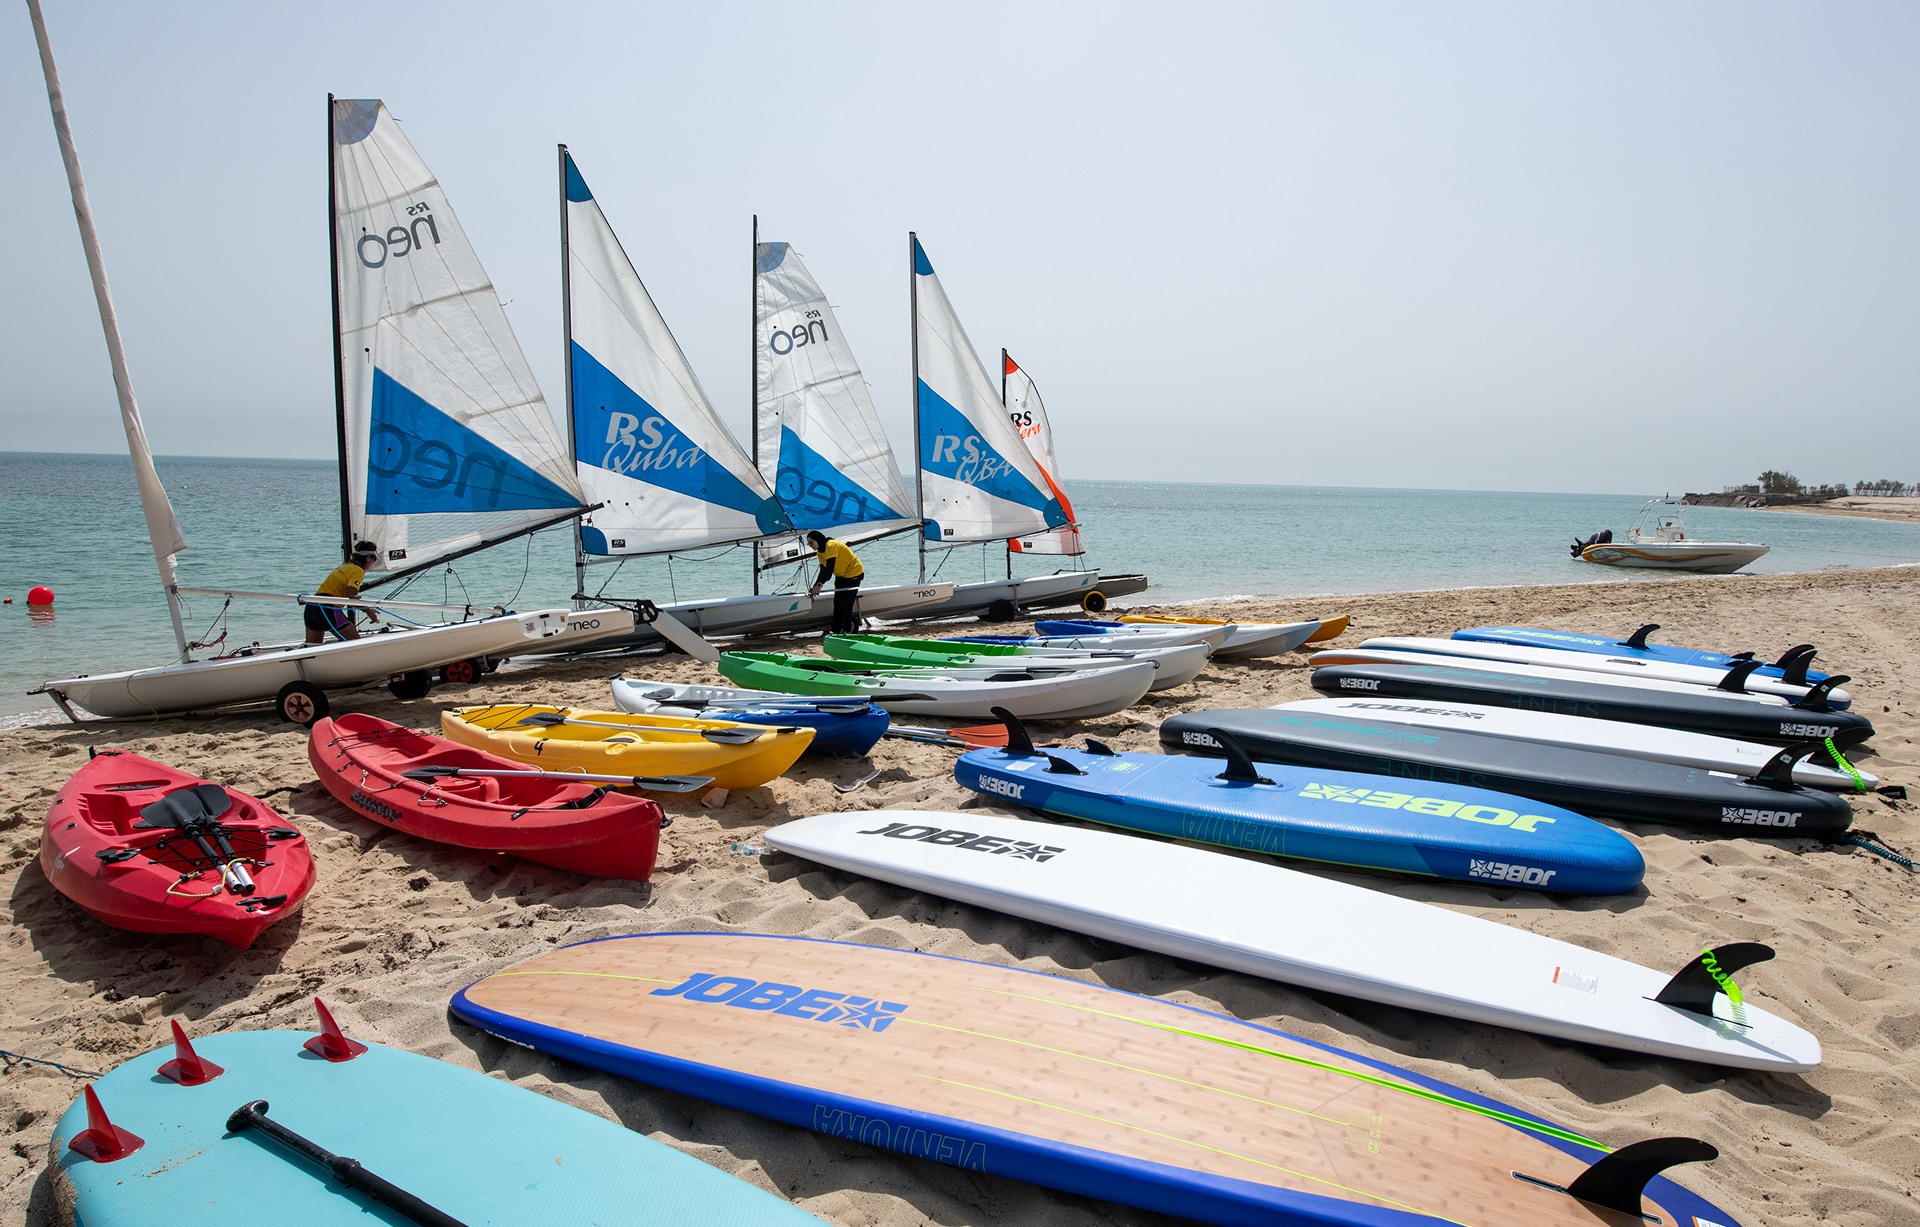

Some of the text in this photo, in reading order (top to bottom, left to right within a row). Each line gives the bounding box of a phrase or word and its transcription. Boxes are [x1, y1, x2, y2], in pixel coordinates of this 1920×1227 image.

[1010, 410, 1032, 427] RS
[605, 411, 666, 449] RS
[601, 434, 706, 475] Quba
[932, 435, 981, 463] RS
[573, 619, 600, 631] neo
[808, 672, 818, 681] 2
[1349, 678, 1381, 690] JOBE
[1336, 702, 1450, 715] JOBE
[1509, 692, 1600, 718] SEINE
[1262, 715, 1397, 737] JOBE
[1795, 723, 1839, 738] JOBE
[534, 739, 543, 756] 4
[990, 777, 1026, 800] JOBE
[1367, 792, 1557, 833] JOBE
[1742, 808, 1802, 828] JOBE
[856, 822, 1017, 853] JOBE
[1490, 862, 1557, 887] JOBE
[648, 972, 845, 1022] JOBE
